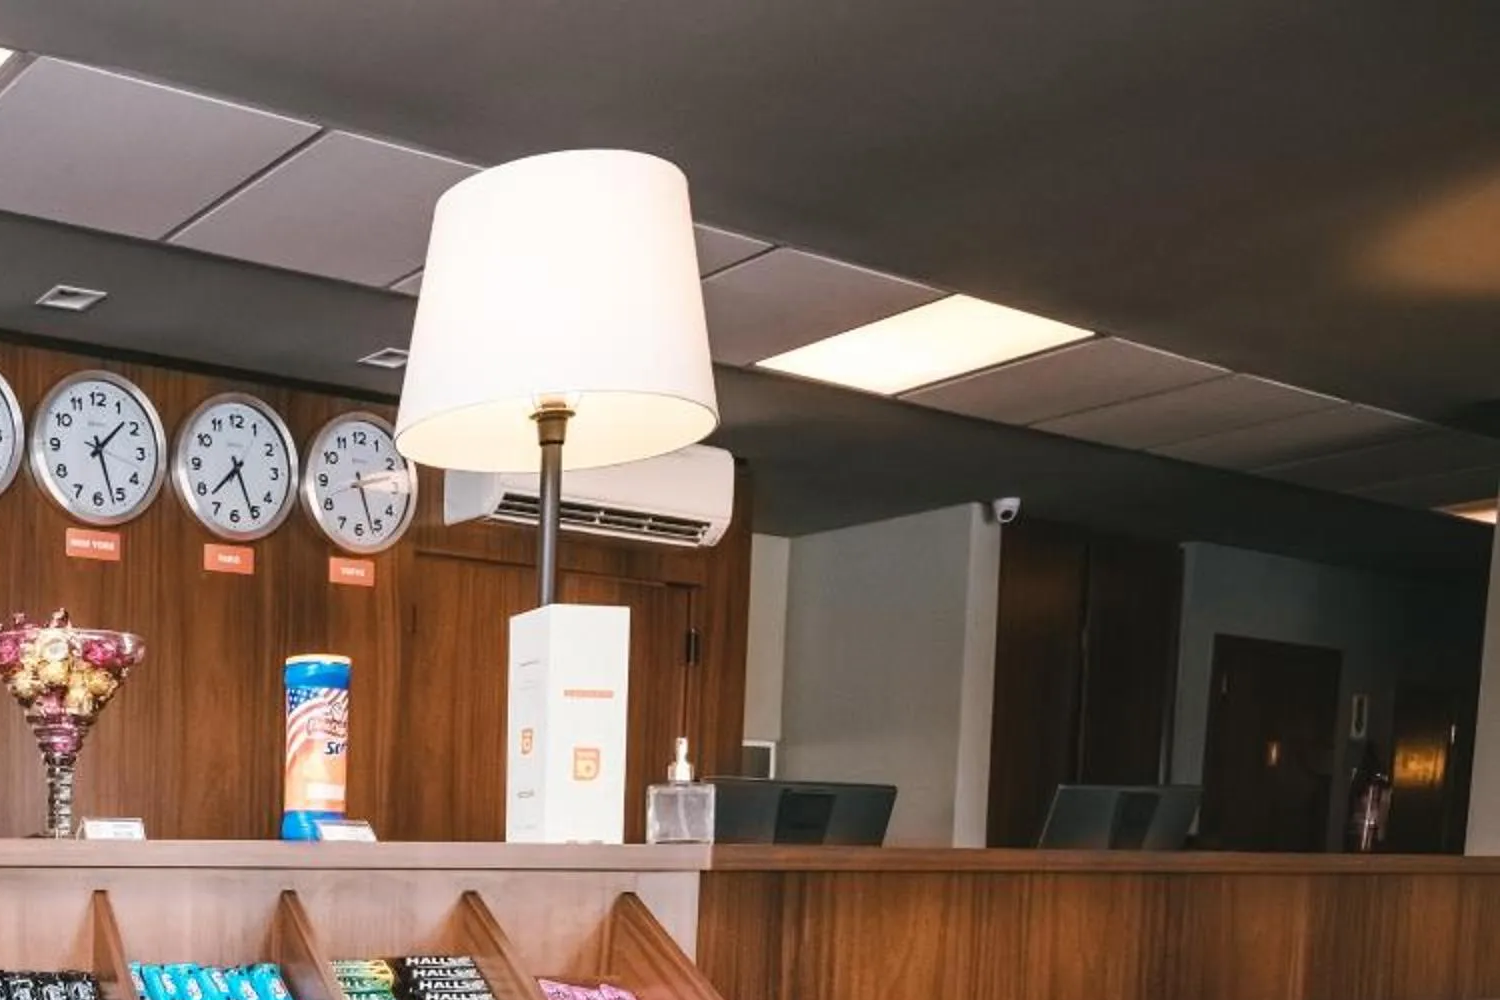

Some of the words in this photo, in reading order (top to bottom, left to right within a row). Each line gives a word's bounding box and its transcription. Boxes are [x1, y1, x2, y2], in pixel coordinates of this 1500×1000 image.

[70, 397, 83, 411] 11
[89, 391, 106, 407] 12
[115, 401, 121, 414] 1
[55, 413, 73, 427] 10
[212, 418, 222, 431] 11
[229, 414, 245, 428] 12
[129, 422, 139, 436] 2
[251, 423, 257, 436] 1
[50, 438, 60, 450] 9
[197, 434, 212, 447] 10
[336, 436, 347, 449] 11
[351, 432, 367, 445] 12
[265, 444, 274, 457] 2
[374, 440, 379, 452] 1
[136, 448, 145, 461] 3
[323, 452, 339, 464] 10
[192, 458, 201, 470] 9
[386, 458, 394, 470] 2
[56, 464, 68, 478] 8
[270, 468, 279, 480] 3
[129, 472, 139, 485] 4
[318, 474, 328, 487] 9
[74, 484, 83, 499] 7
[116, 488, 125, 501] 5
[197, 482, 207, 496] 8
[93, 492, 104, 506] 6
[264, 491, 273, 504] 4
[324, 498, 334, 510] 8
[212, 502, 221, 516] 7
[385, 504, 393, 516] 4
[229, 510, 240, 523] 6
[338, 517, 347, 529] 7
[354, 524, 364, 536] 6
[374, 519, 382, 531] 5
